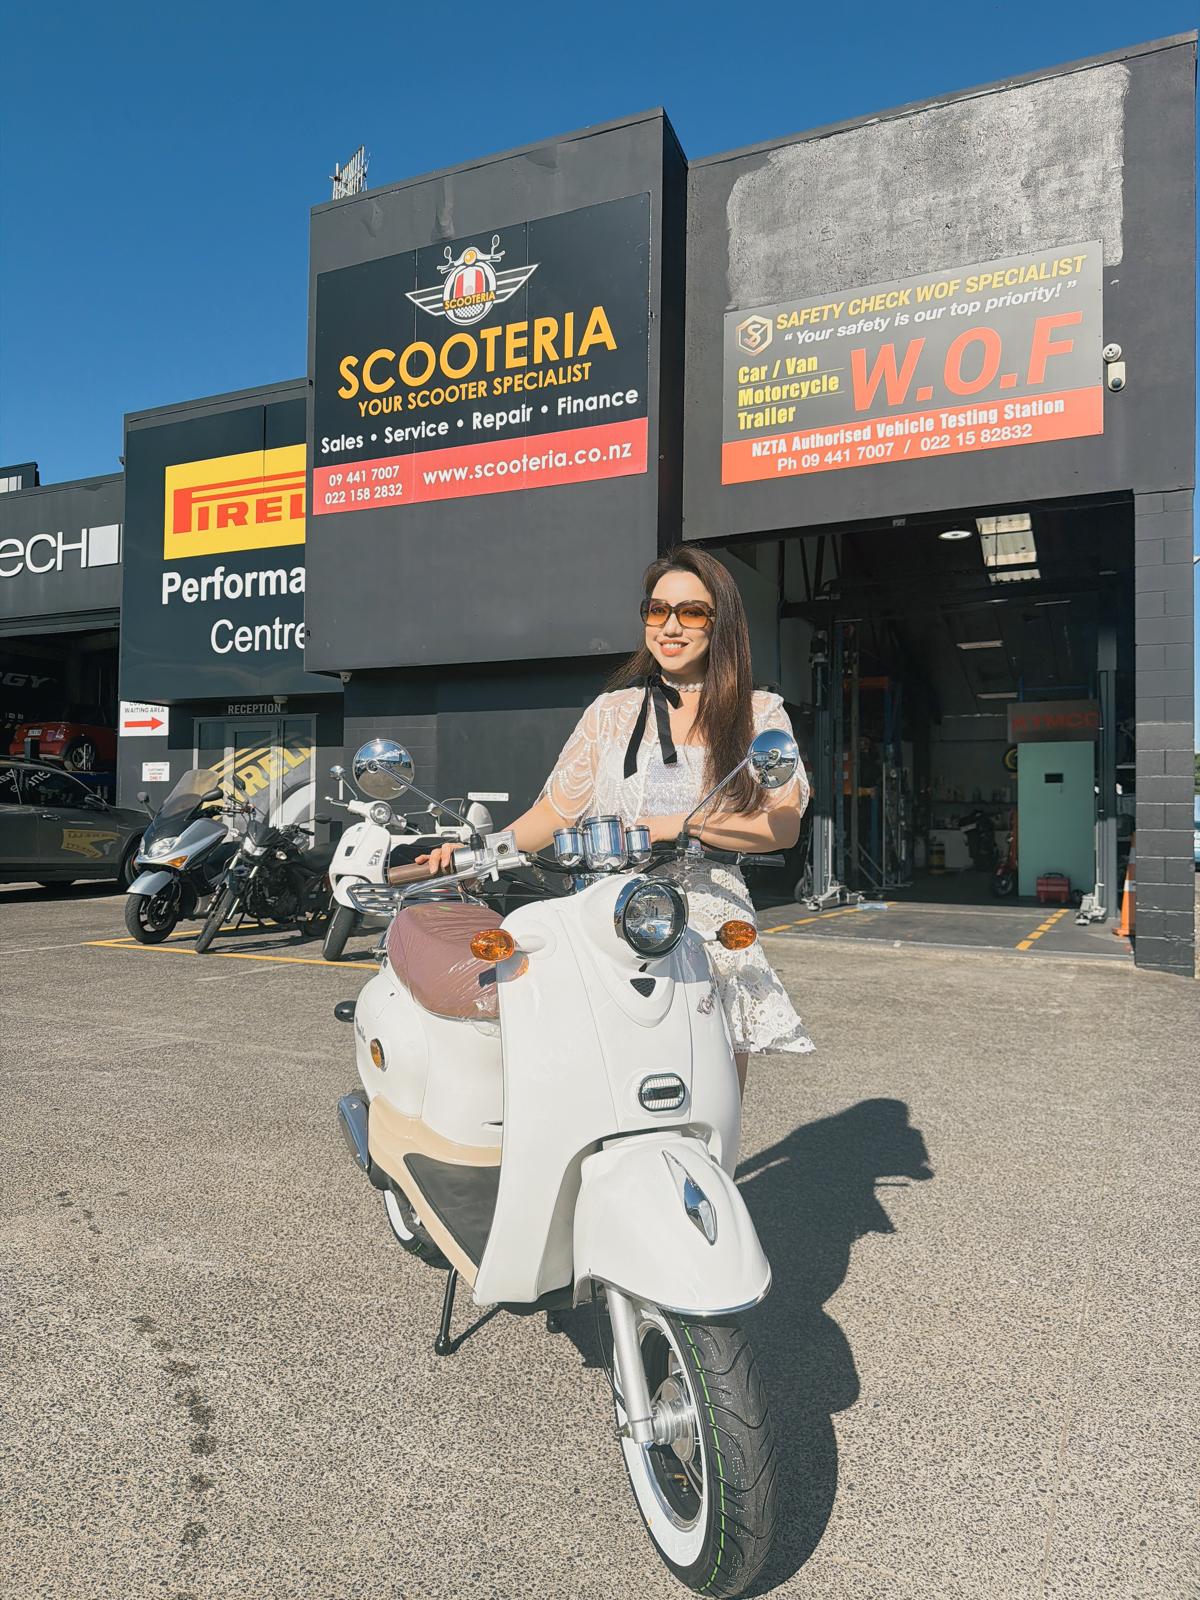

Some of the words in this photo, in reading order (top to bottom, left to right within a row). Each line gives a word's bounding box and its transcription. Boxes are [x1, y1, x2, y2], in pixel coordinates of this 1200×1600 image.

[444, 291, 496, 310] SCOOTERIA
[776, 302, 846, 330] SAFETY
[848, 288, 912, 316] CHECK
[916, 279, 961, 303] WOF
[965, 255, 1087, 294] SPECIALIST
[836, 316, 891, 338] safety
[894, 312, 909, 326] is
[914, 305, 947, 322] our
[950, 301, 981, 317] top
[984, 283, 1063, 314] priority!
[338, 305, 618, 400] SCOOTERIA
[738, 363, 769, 385] Car
[785, 356, 818, 376] Van
[850, 310, 1083, 412] W.O.F
[358, 396, 403, 418] YOUR
[407, 381, 488, 410] SCOOTER
[493, 362, 592, 396] SPECIALIST
[738, 374, 840, 408] Motorcycle
[321, 431, 364, 454] Sales
[384, 420, 449, 444] Service
[472, 405, 533, 431] Repair
[557, 389, 639, 416] Finance
[737, 406, 796, 431] Trailer
[752, 438, 787, 458] NZTA
[792, 423, 871, 451] Authorised
[876, 416, 935, 438] Vehicle
[940, 408, 998, 430] Testing
[1004, 399, 1065, 421] Station
[423, 440, 632, 486] www.scooteria.co.nz
[777, 455, 797, 473] Ph
[801, 453, 820, 469] 09
[824, 450, 851, 466] 441
[856, 442, 895, 461] 7007
[920, 434, 951, 451] 022
[956, 431, 976, 447] 15
[980, 423, 1033, 444] 82832
[325, 490, 346, 505] 022
[350, 487, 371, 502] 158
[373, 483, 403, 500] 2832
[329, 473, 343, 487] 09
[346, 470, 367, 484] 441
[371, 465, 400, 480] 7007
[162, 566, 306, 606] Performa
[210, 616, 305, 654] Centre
[228, 703, 281, 716] RECEPTION
